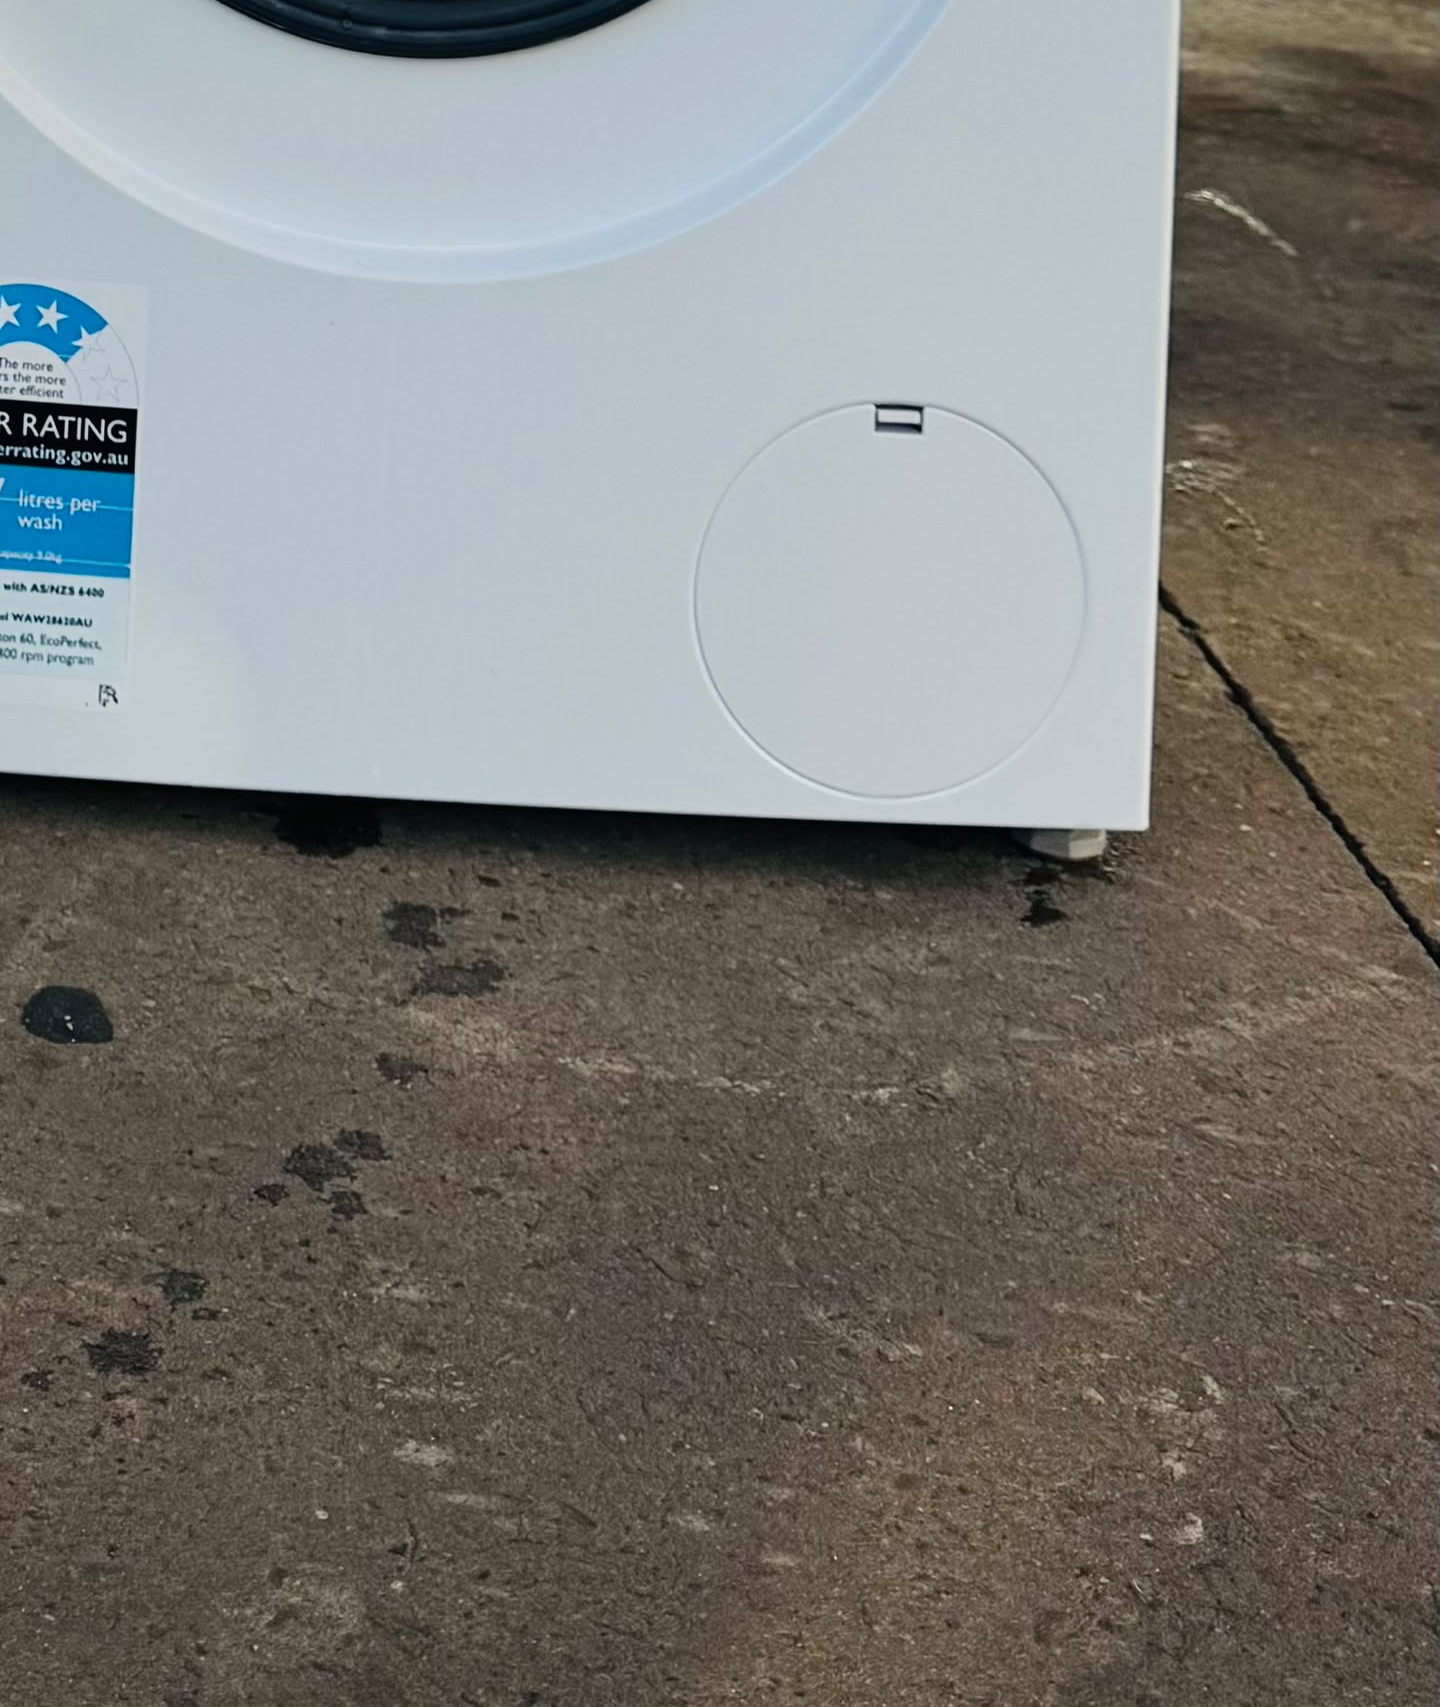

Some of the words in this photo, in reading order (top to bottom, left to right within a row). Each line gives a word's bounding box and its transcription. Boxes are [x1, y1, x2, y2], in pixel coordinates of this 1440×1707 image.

[22, 361, 53, 372] more
[13, 372, 32, 384] the
[35, 375, 67, 386] more
[19, 385, 64, 398] efficient
[22, 413, 128, 443] RATING
[17, 488, 64, 510] litres
[69, 497, 101, 515] per
[17, 513, 63, 531] wash
[3, 580, 27, 592] with
[20, 650, 44, 663] rpm
[46, 653, 95, 667] program
